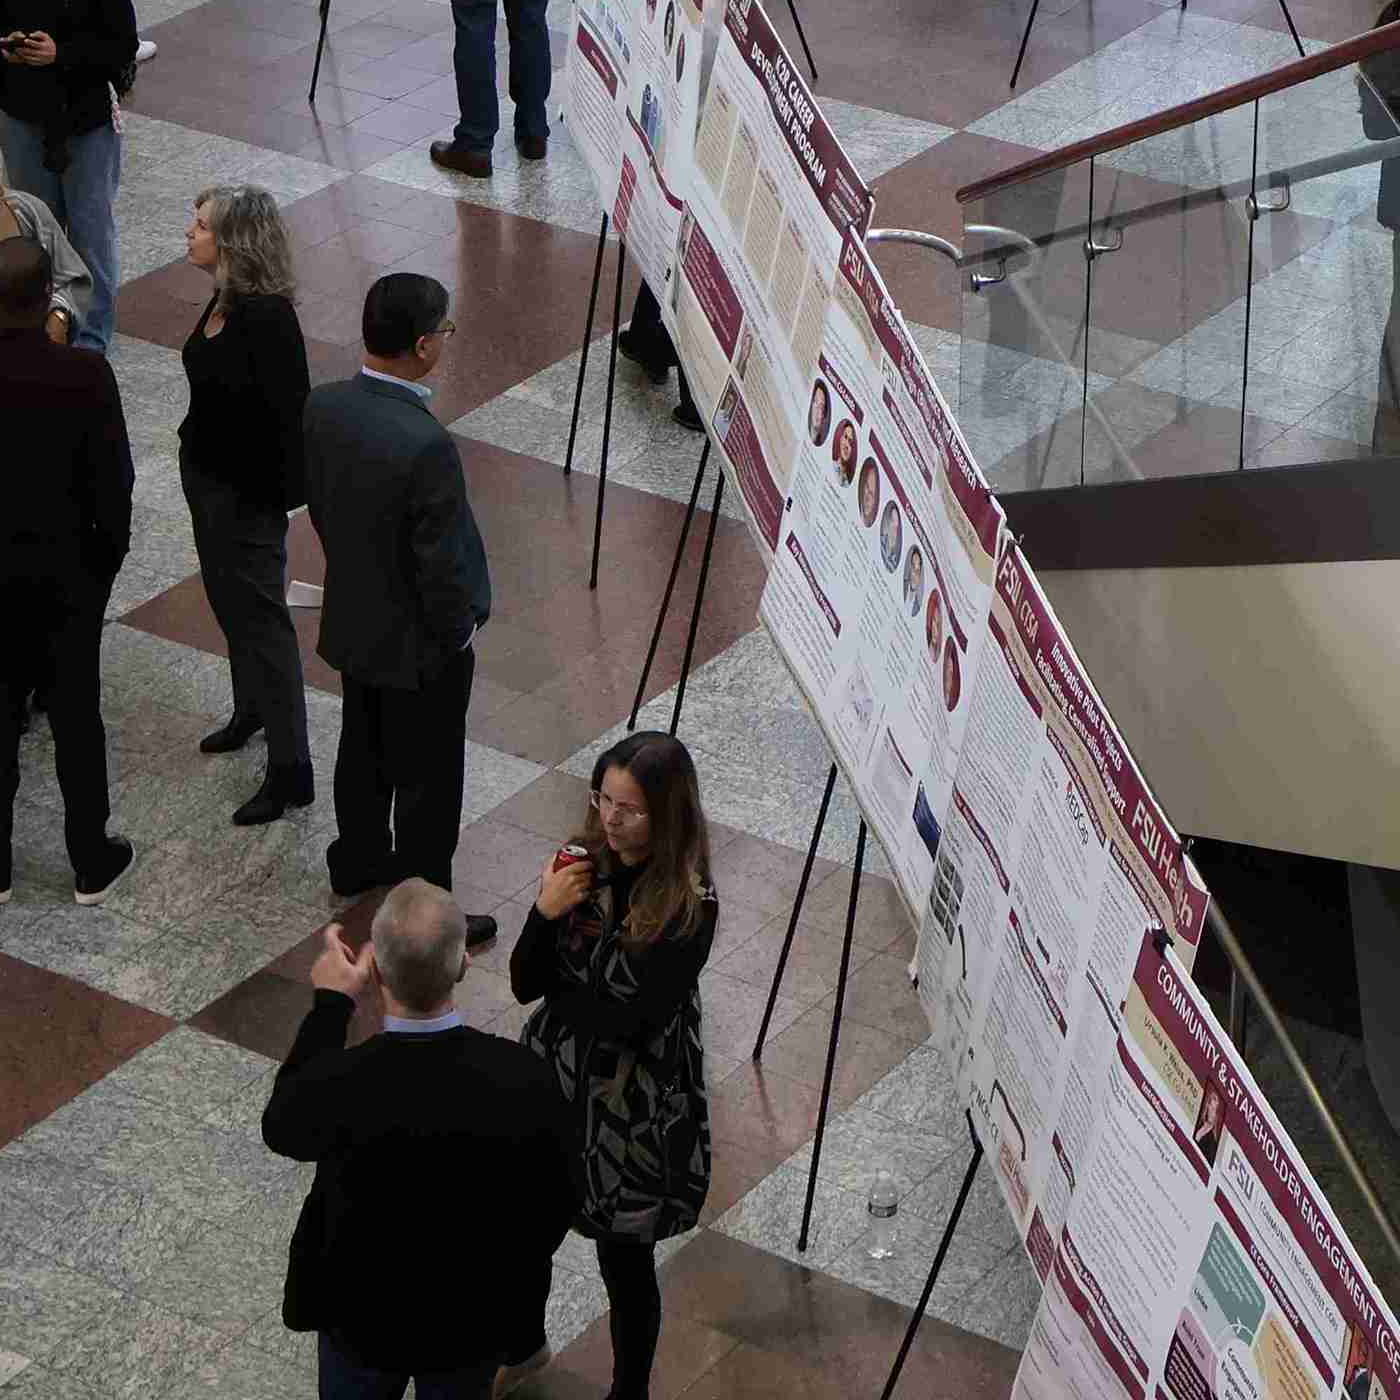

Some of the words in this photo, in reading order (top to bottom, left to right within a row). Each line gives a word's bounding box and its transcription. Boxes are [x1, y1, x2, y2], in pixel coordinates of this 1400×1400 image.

[751, 41, 792, 127] DEVELOPMENT
[790, 120, 827, 187] PROGRAM
[775, 54, 790, 89] K2R
[788, 80, 815, 133] CAREER
[844, 248, 865, 283] FSU
[999, 558, 1024, 605] FSU
[1021, 600, 1040, 643] CTSA
[1035, 648, 1068, 714] Facilitating
[1067, 703, 1104, 769] Centralized
[1101, 762, 1127, 815] Support
[1050, 641, 1084, 703] Innovative
[1083, 692, 1100, 730] Pilot
[1098, 721, 1124, 771] Projects
[1132, 800, 1162, 856] FSU
[1157, 964, 1220, 1069] COMMUNITY
[1218, 1064, 1229, 1087] &
[1227, 1079, 1301, 1207] STAKEHOLDER
[1301, 1202, 1377, 1329] ENGAGEMENT
[1228, 1149, 1255, 1202] FSU
